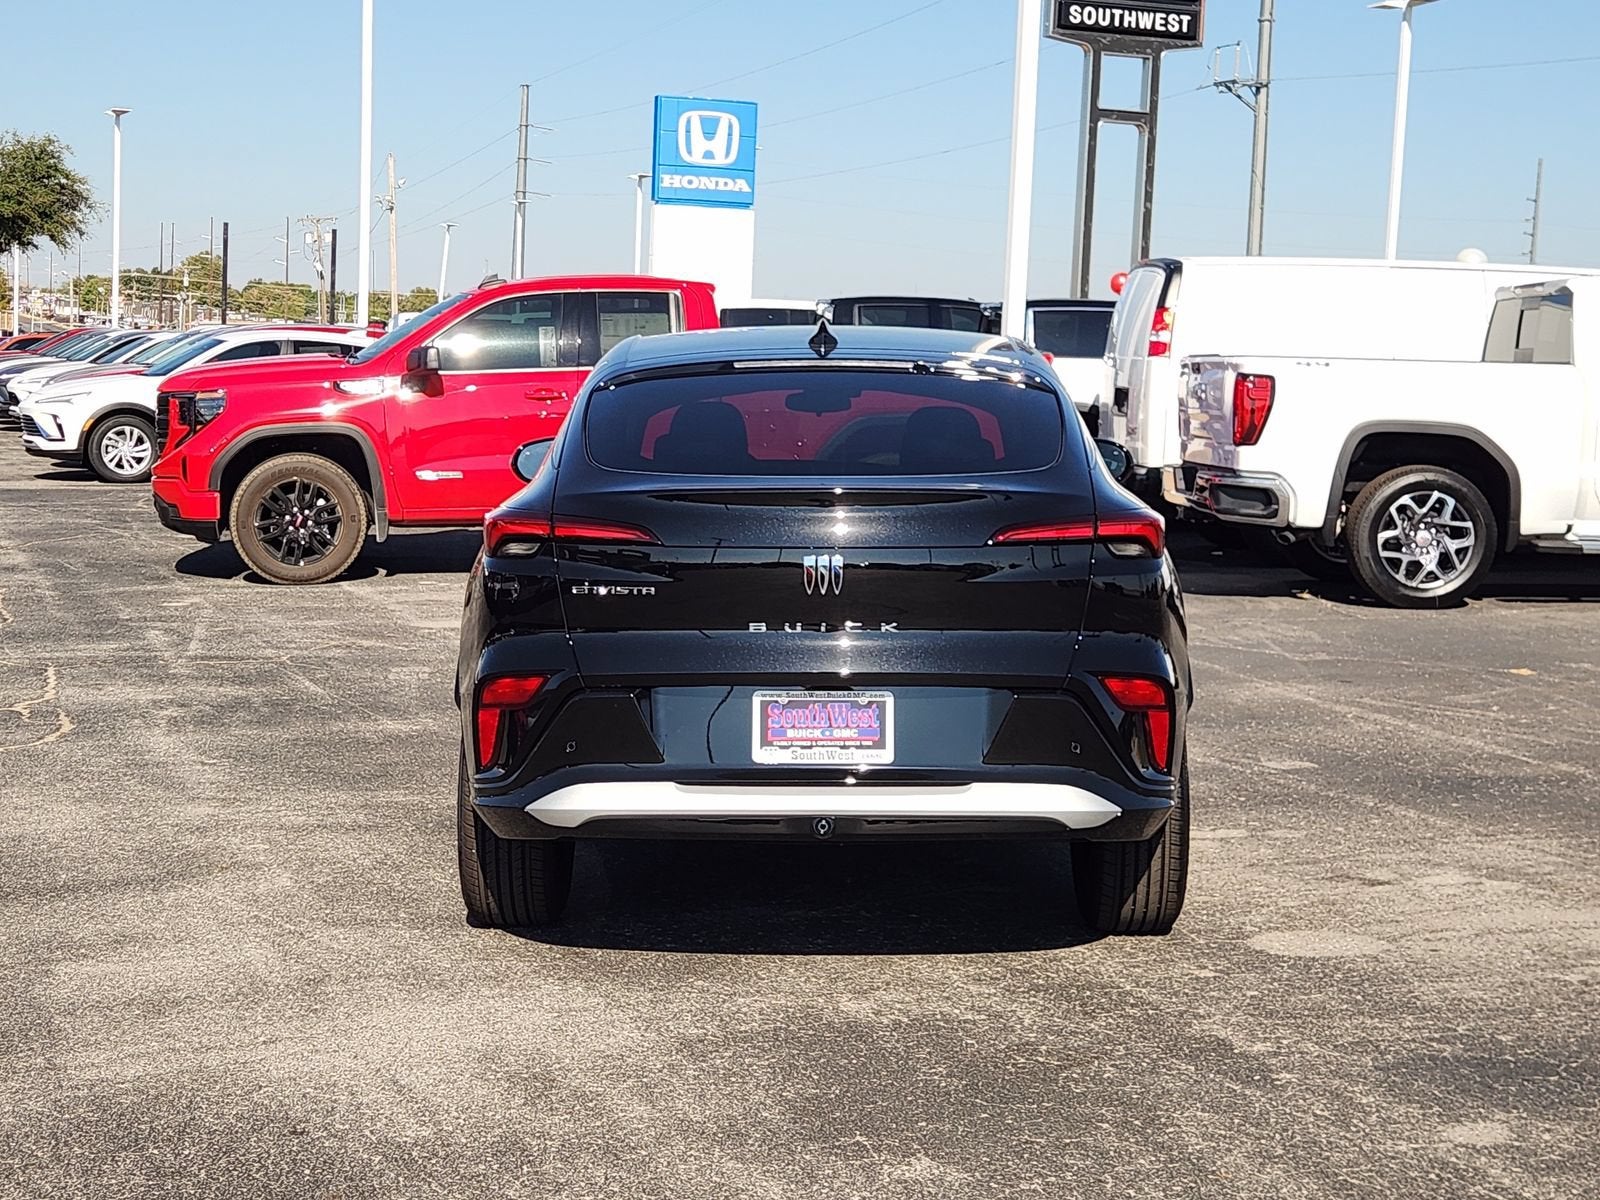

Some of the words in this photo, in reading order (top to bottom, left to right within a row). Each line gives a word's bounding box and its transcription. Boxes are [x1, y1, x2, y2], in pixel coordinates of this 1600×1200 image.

[1069, 5, 1192, 33] SOUTHWEST
[660, 174, 752, 192] HONDA
[748, 622, 900, 633] BUICK
[767, 702, 880, 728] SouthWest
[786, 728, 822, 738] BUICK
[832, 728, 859, 738] GMC
[791, 750, 855, 761] SouthWest
